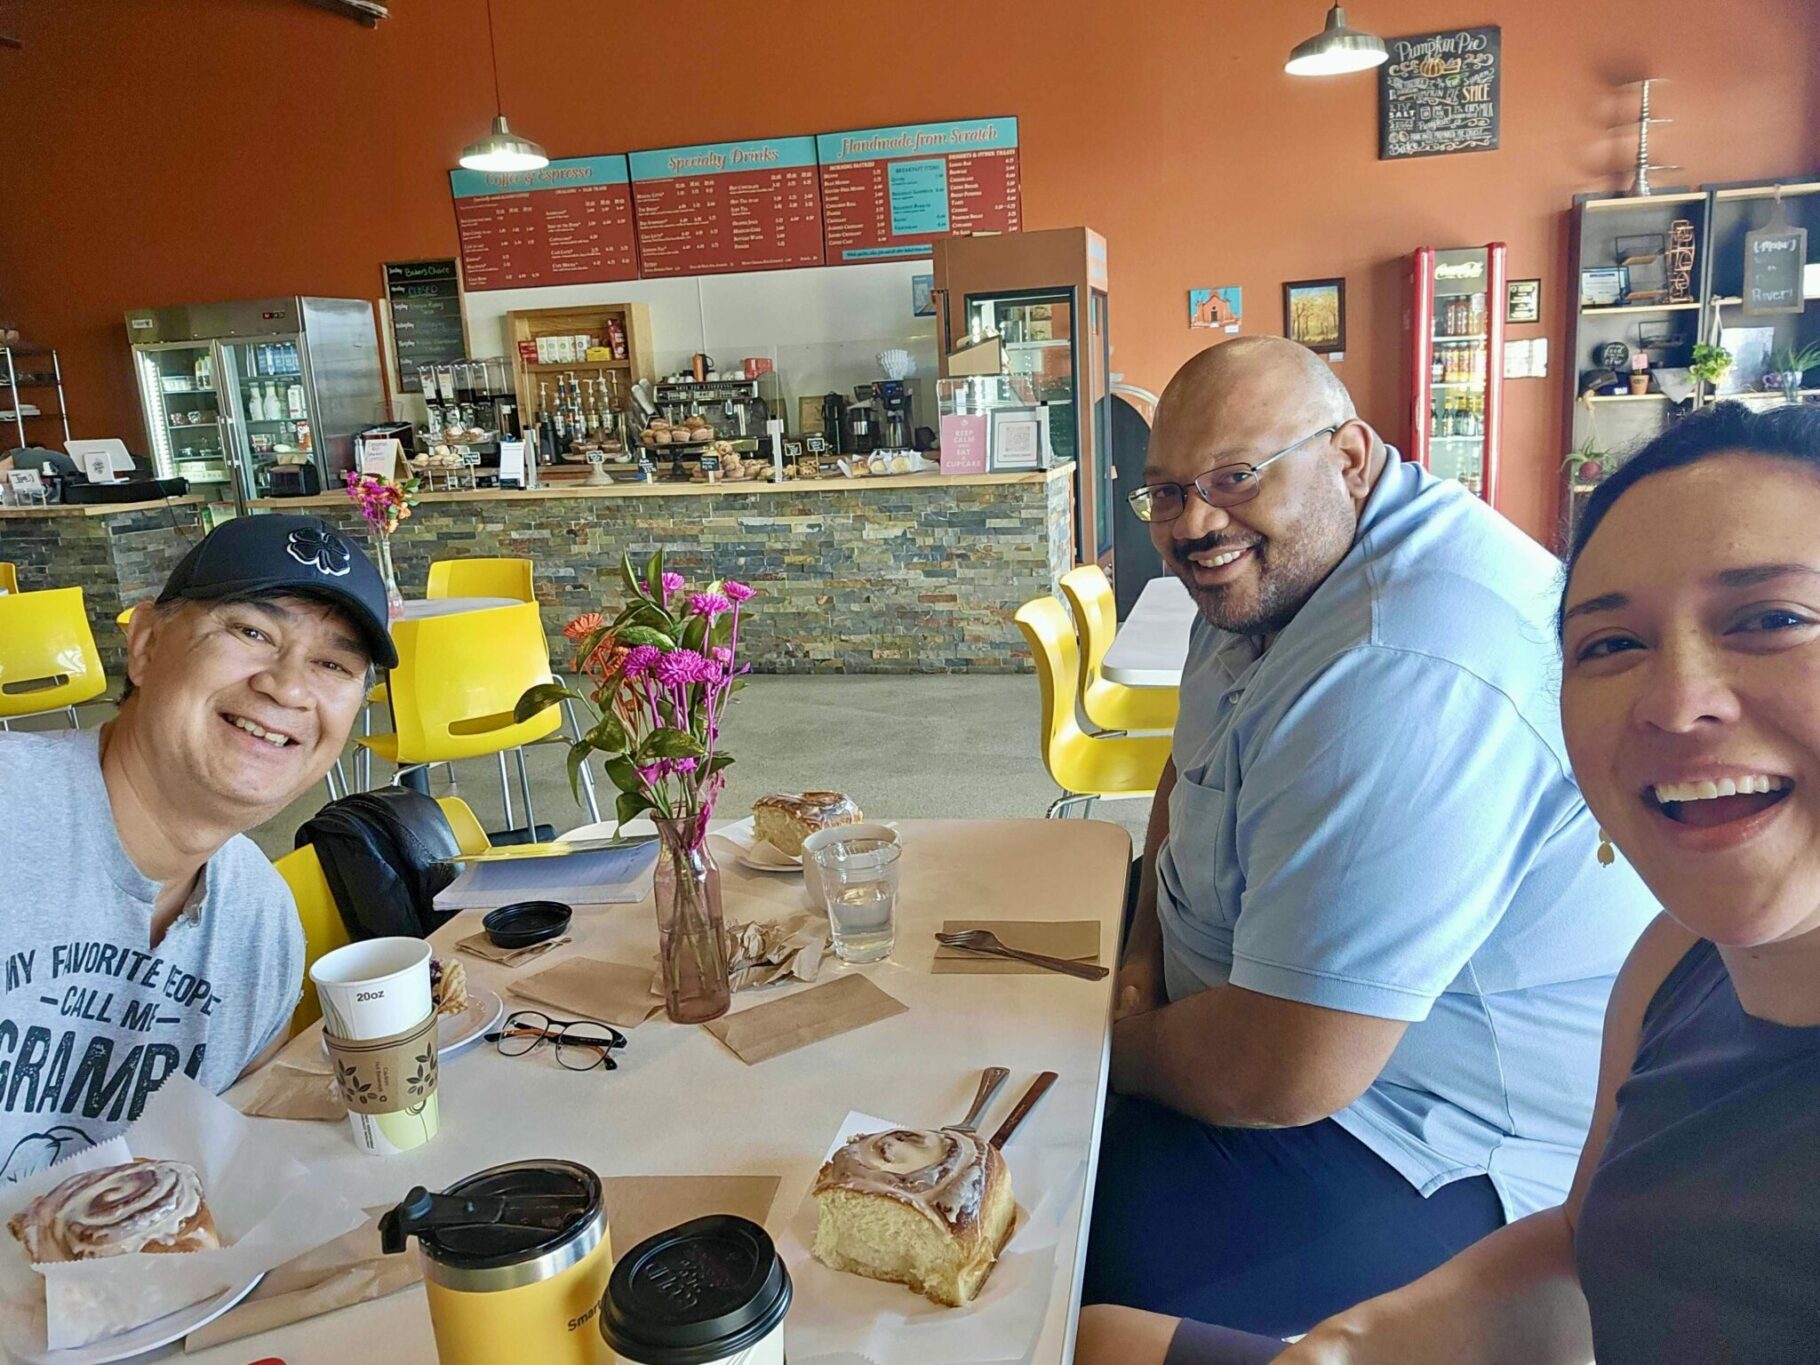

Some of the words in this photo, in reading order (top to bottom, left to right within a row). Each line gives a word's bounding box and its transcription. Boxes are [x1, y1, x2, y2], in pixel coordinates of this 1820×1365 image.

[1394, 35, 1455, 61] Pumpkin
[1455, 32, 1487, 55] Pie
[1461, 83, 1491, 104] SPICE
[1389, 110, 1416, 119] SALT
[837, 136, 912, 160] Handmade
[913, 131, 947, 152] from
[951, 125, 998, 144] Scratch
[668, 152, 727, 175] Specialty
[732, 146, 778, 164] Drinks
[5, 949, 36, 994] MY
[52, 942, 164, 989] FAVORITE
[356, 990, 385, 1002] 20oz
